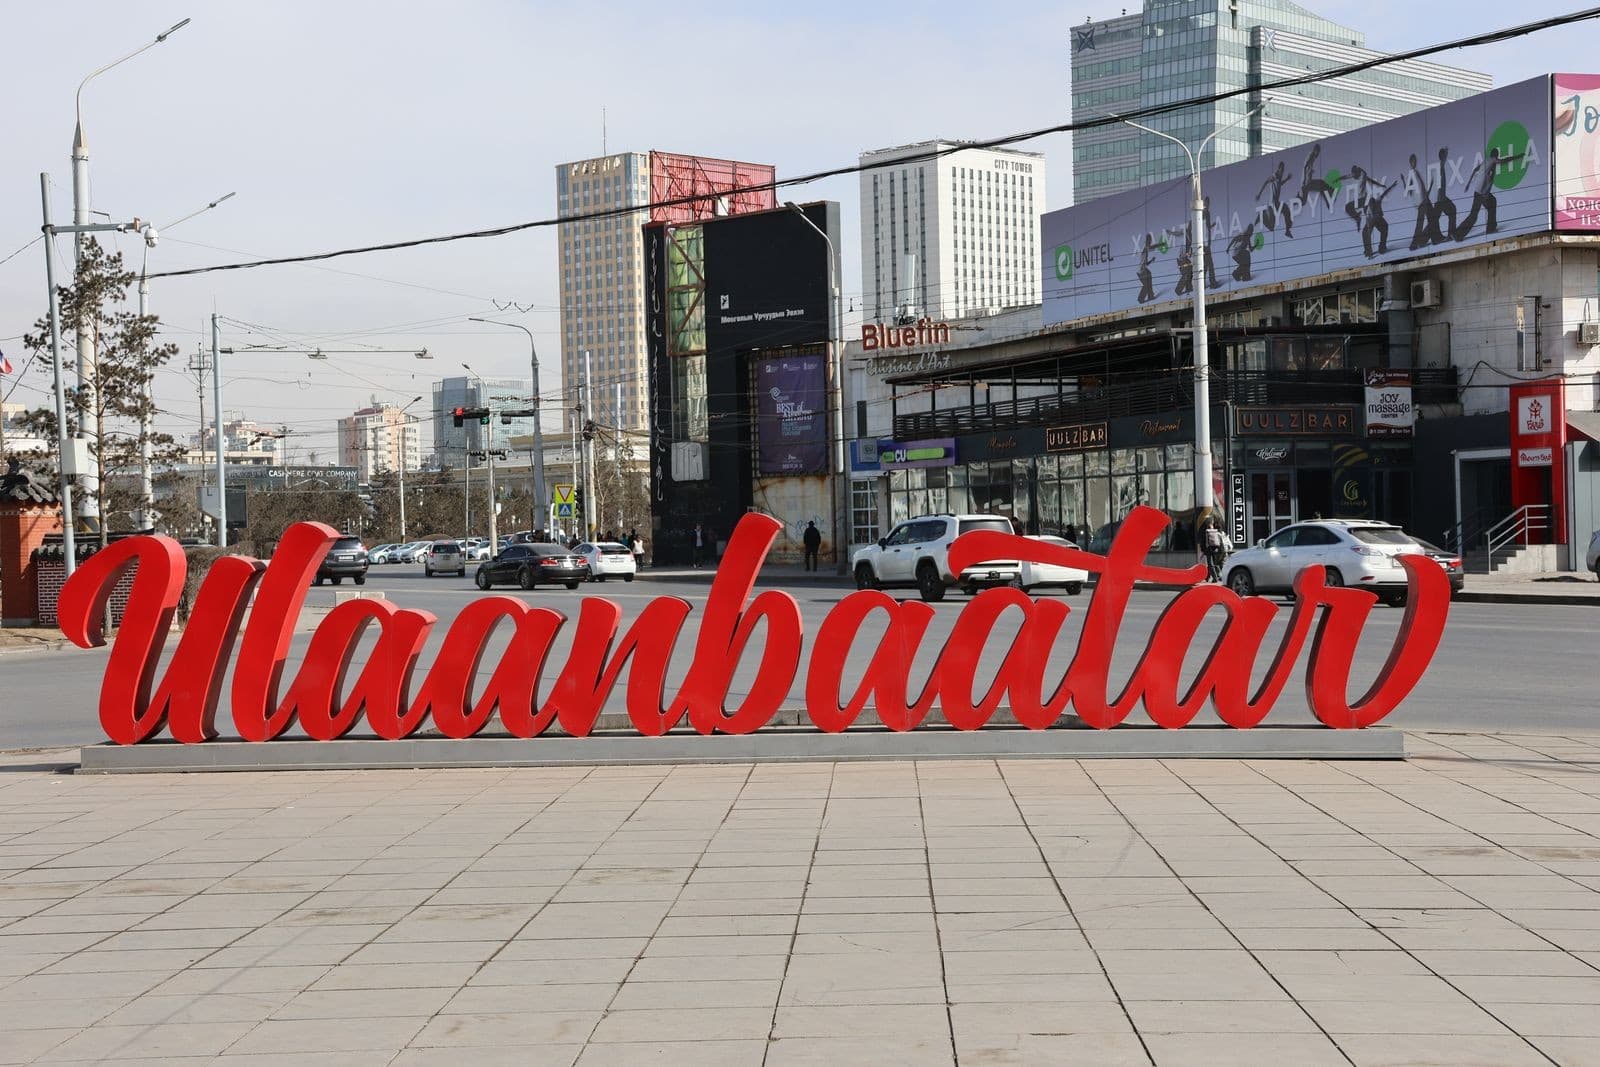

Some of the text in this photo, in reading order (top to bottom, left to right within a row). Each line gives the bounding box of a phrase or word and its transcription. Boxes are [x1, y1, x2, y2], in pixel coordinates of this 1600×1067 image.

[994, 159, 1033, 174] CITY TOWER
[1074, 243, 1114, 269] UNITEL
[861, 317, 951, 351] Bluefin
[1380, 393, 1400, 404] JOY
[1368, 402, 1411, 416] massage
[1242, 412, 1348, 429] UULZ BAR
[1049, 428, 1105, 446] UULZ BAR
[895, 449, 906, 462] CU
[326, 469, 357, 478] COMPANY
[1234, 477, 1244, 542] UULZ BAR
[57, 504, 1452, 745] Ulaanbaatar
